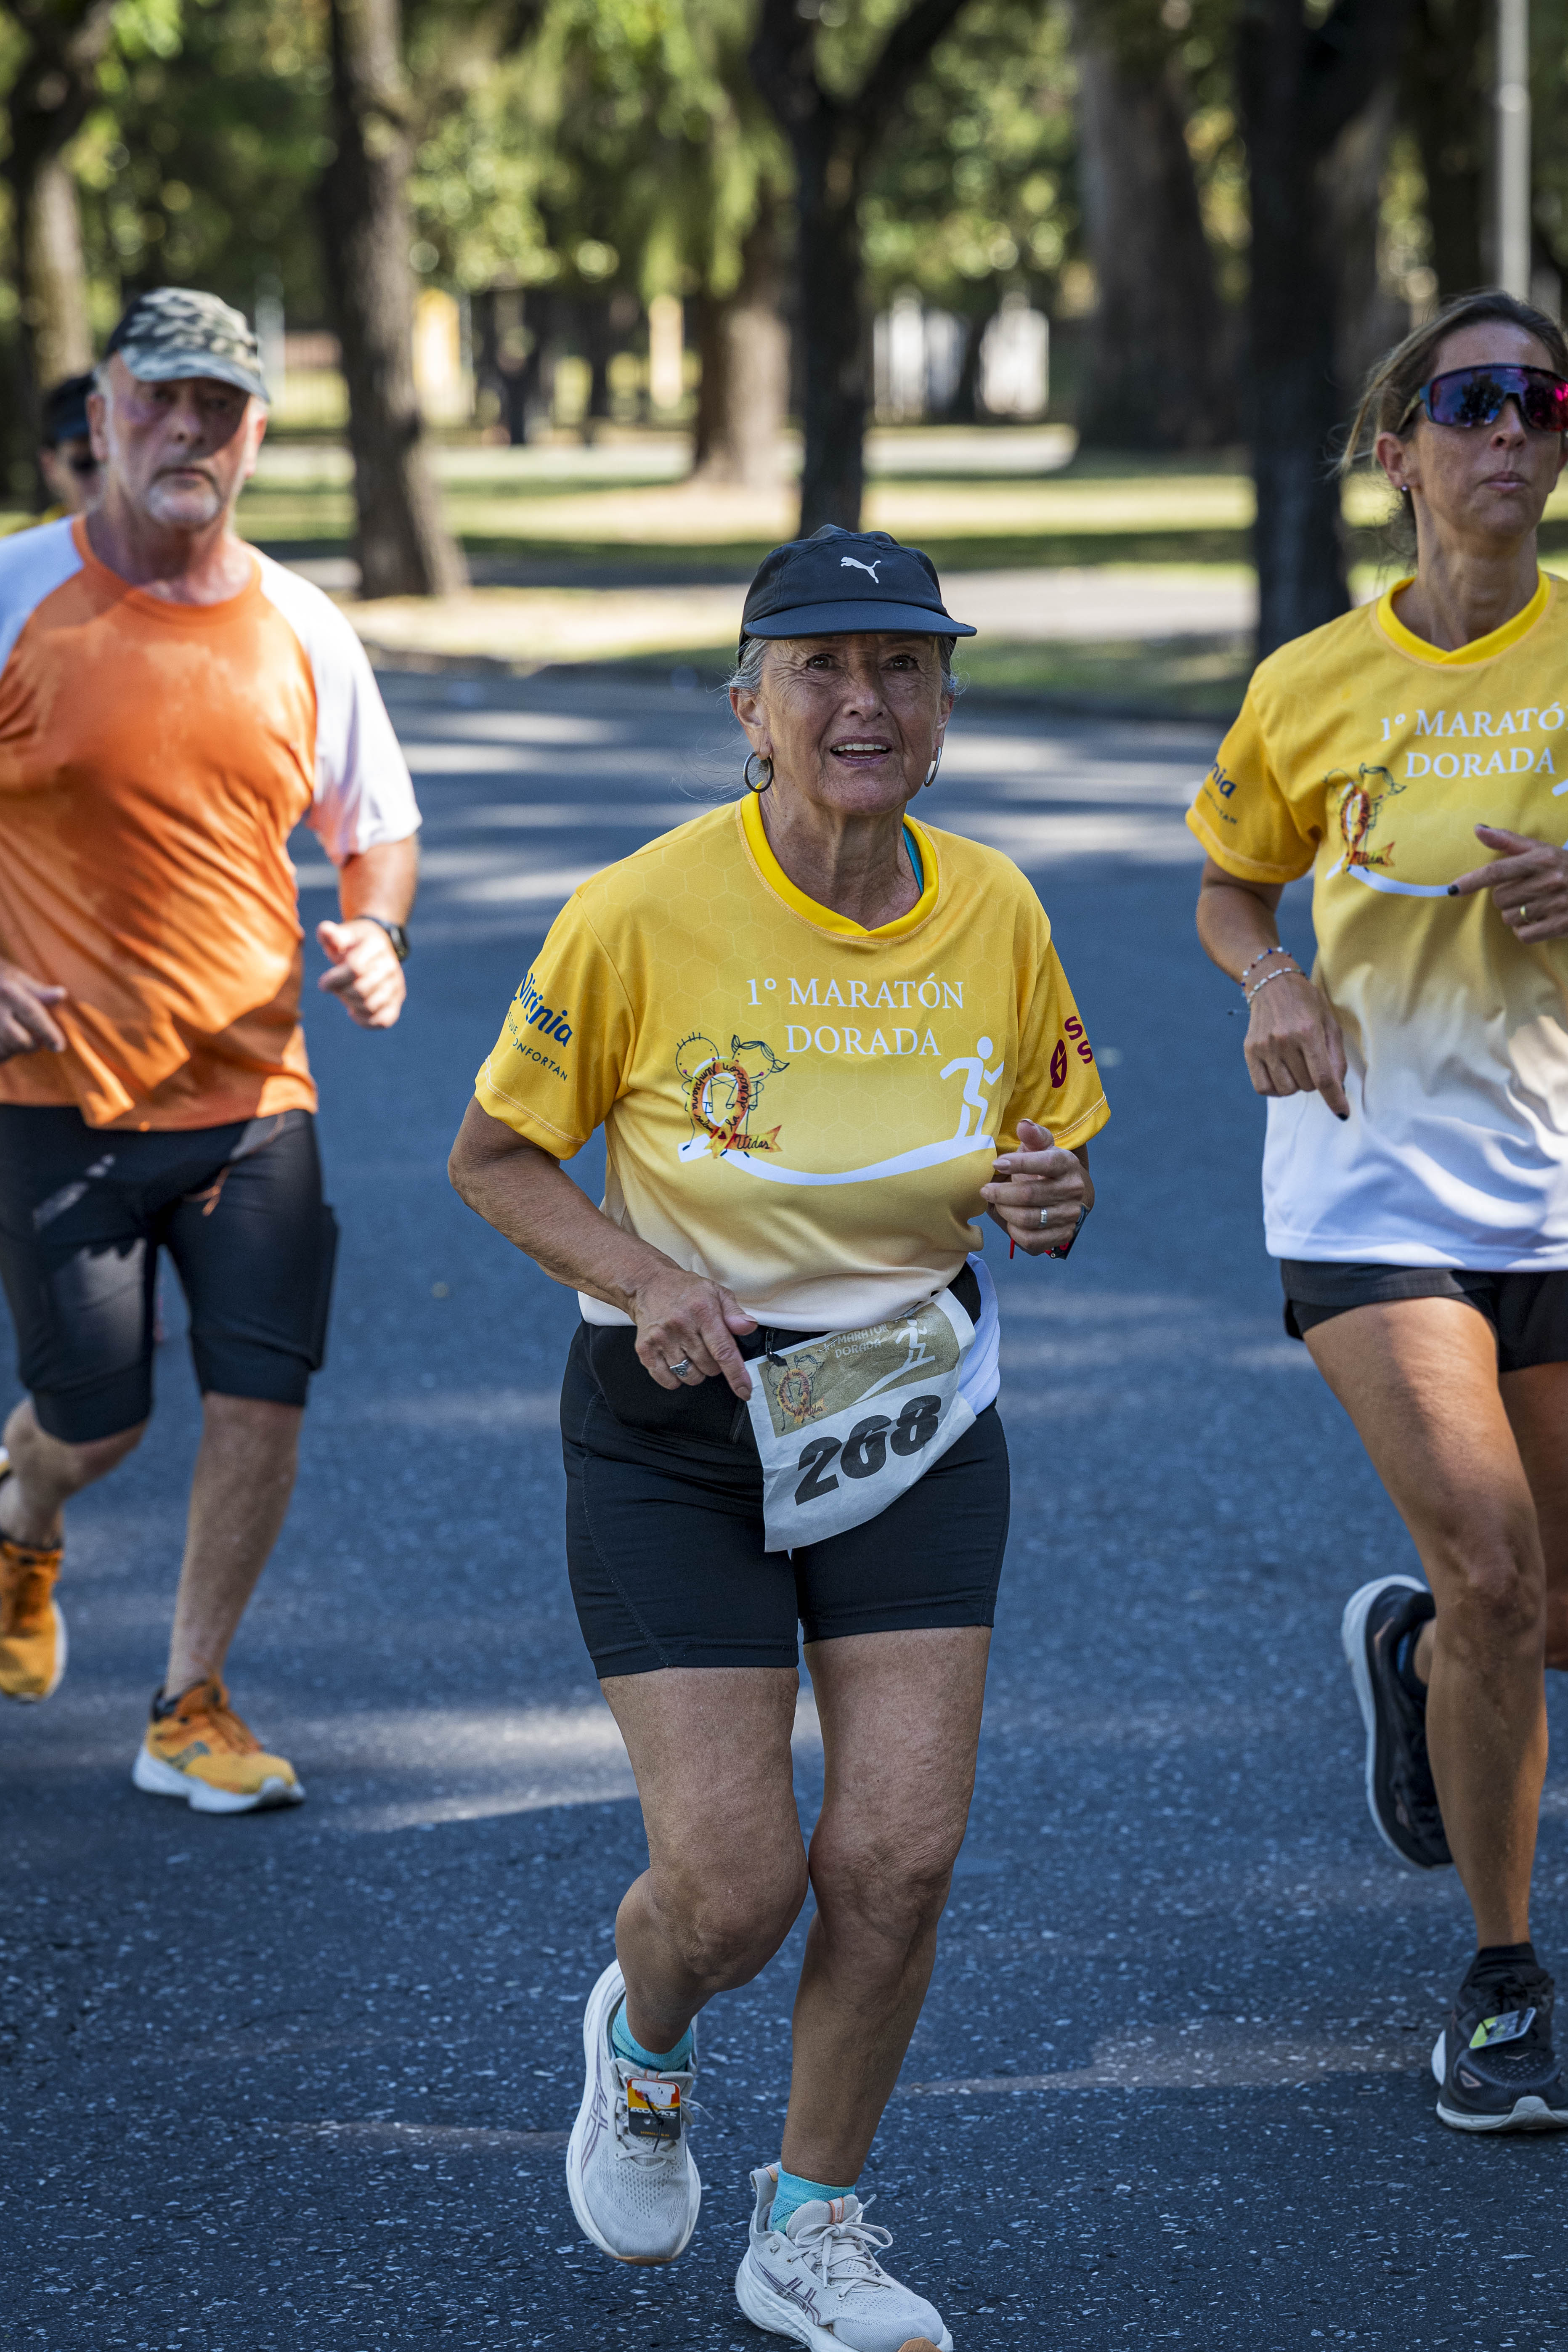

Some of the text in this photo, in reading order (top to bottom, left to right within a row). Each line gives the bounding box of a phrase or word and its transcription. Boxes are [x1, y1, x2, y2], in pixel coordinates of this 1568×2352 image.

[1414, 701, 1568, 737] MARATÓ
[1404, 747, 1556, 778] DORADA
[788, 972, 963, 1009] MARATÓN
[785, 1025, 942, 1055] DORADA
[794, 1395, 942, 1506] 268
